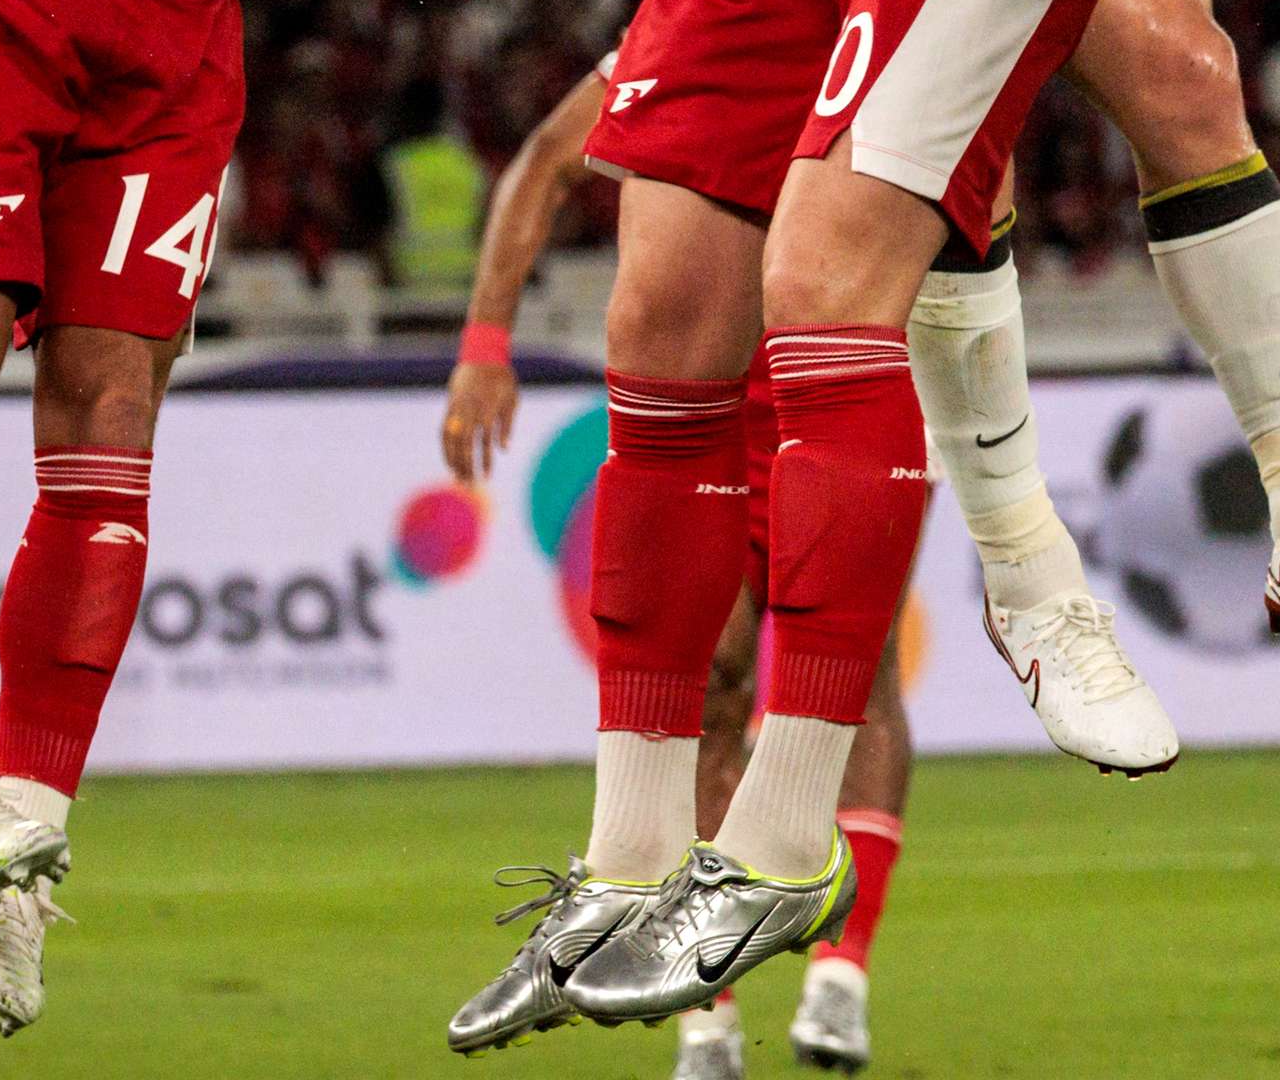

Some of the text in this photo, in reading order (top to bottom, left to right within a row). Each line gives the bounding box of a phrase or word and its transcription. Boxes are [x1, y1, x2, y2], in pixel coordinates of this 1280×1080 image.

[815, 8, 874, 116] 0
[100, 173, 215, 300] 14
[140, 550, 385, 647] osat
